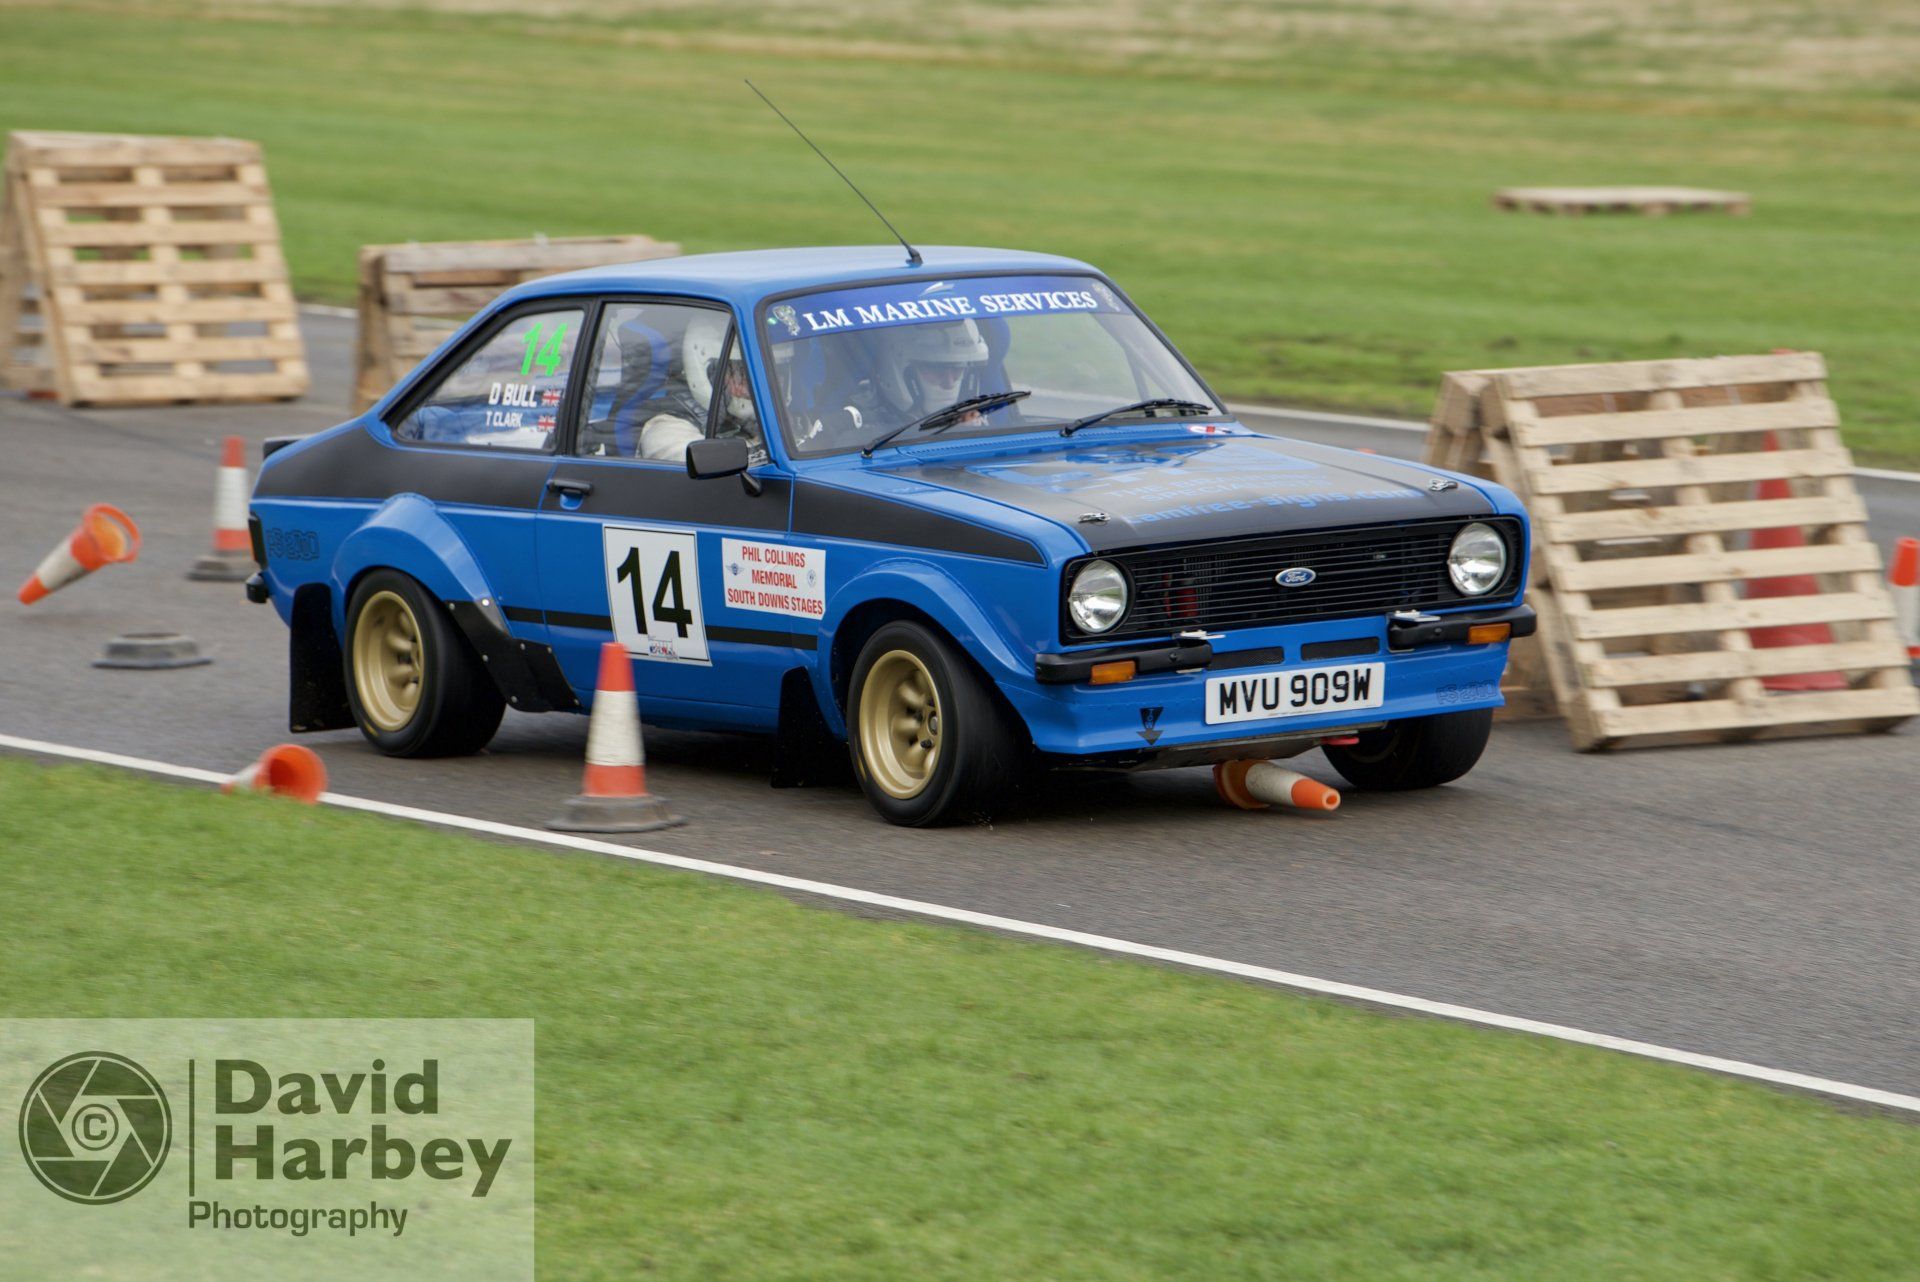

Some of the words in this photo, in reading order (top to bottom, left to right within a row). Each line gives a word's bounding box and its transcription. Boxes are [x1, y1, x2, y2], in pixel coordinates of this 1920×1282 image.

[803, 307, 853, 331] LM
[854, 296, 977, 325] MARINE
[979, 291, 1099, 313] SERVICES
[521, 322, 568, 376] 14
[488, 382, 502, 405] D
[502, 383, 538, 408] BULL
[485, 411, 493, 427] T
[493, 411, 523, 427] CLARK
[742, 545, 763, 563] PHIL
[765, 548, 806, 568] COLLINGS
[616, 546, 693, 638] 14
[751, 569, 798, 589] MEMORIAL
[728, 588, 756, 605] SOUTH
[758, 592, 790, 610] DOWNS
[791, 596, 824, 615] STAGES
[1219, 677, 1281, 716] MVU
[1290, 668, 1372, 707] 909W
